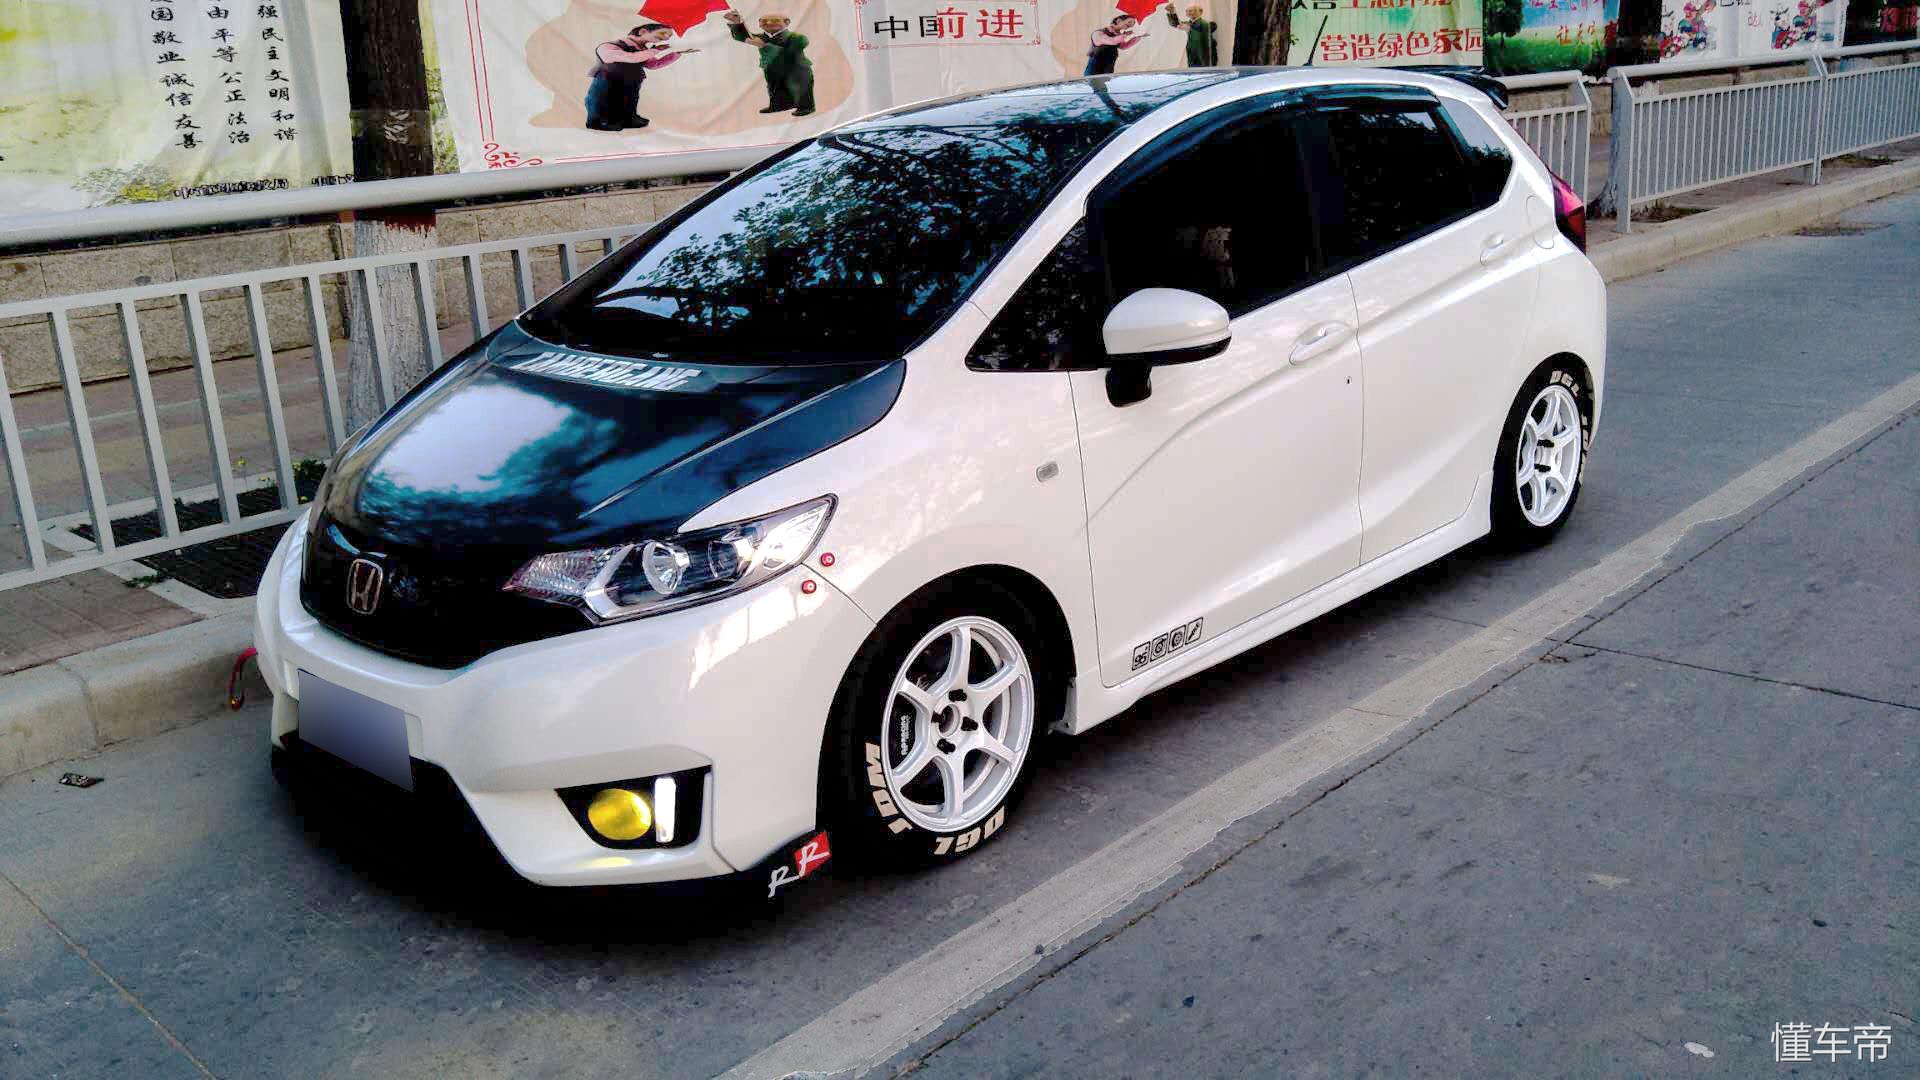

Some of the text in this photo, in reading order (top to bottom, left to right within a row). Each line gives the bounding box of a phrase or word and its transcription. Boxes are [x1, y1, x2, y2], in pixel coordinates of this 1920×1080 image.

[151, 0, 202, 149] 国敬业诚信友善
[207, 0, 250, 144] 由平等公正法治
[257, 0, 297, 142] 强民主文明和谐
[1320, 28, 1483, 61] 营造绿色家园
